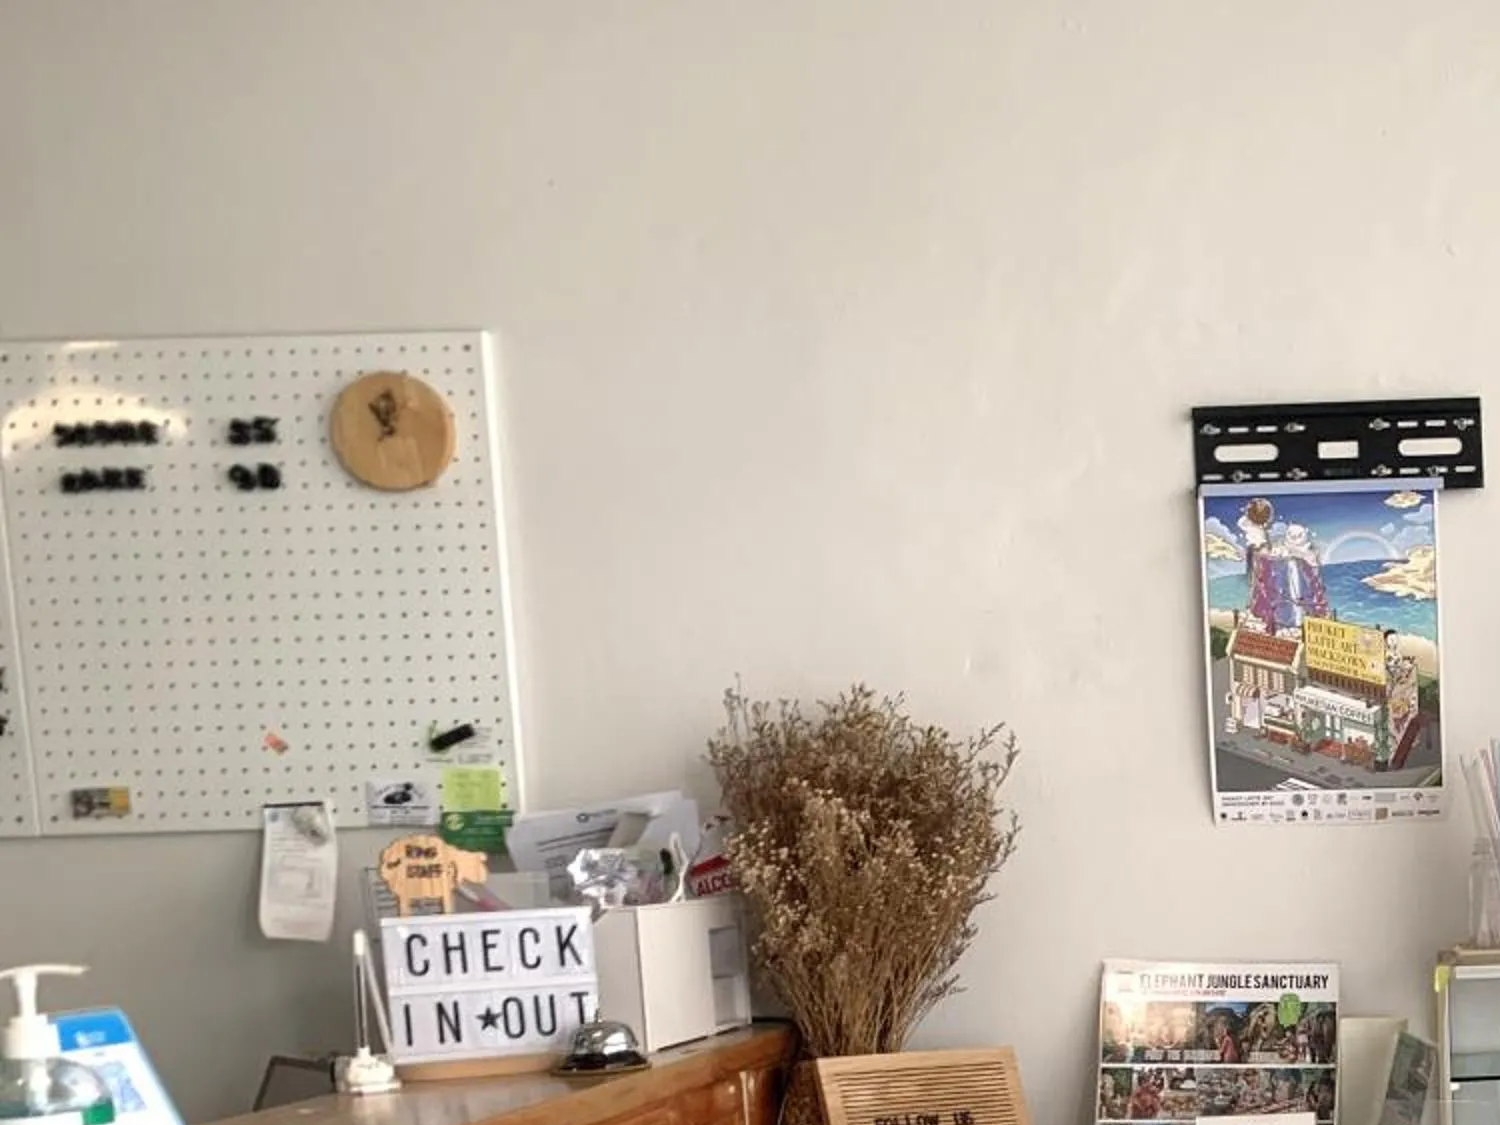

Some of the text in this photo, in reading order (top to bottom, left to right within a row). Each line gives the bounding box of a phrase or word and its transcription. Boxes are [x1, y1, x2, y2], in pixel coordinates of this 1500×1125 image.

[406, 924, 583, 977] CHECK
[1139, 973, 1329, 991] ELEPHANT JUNGLE SANCTUARY
[404, 991, 588, 1047] IN OUT
